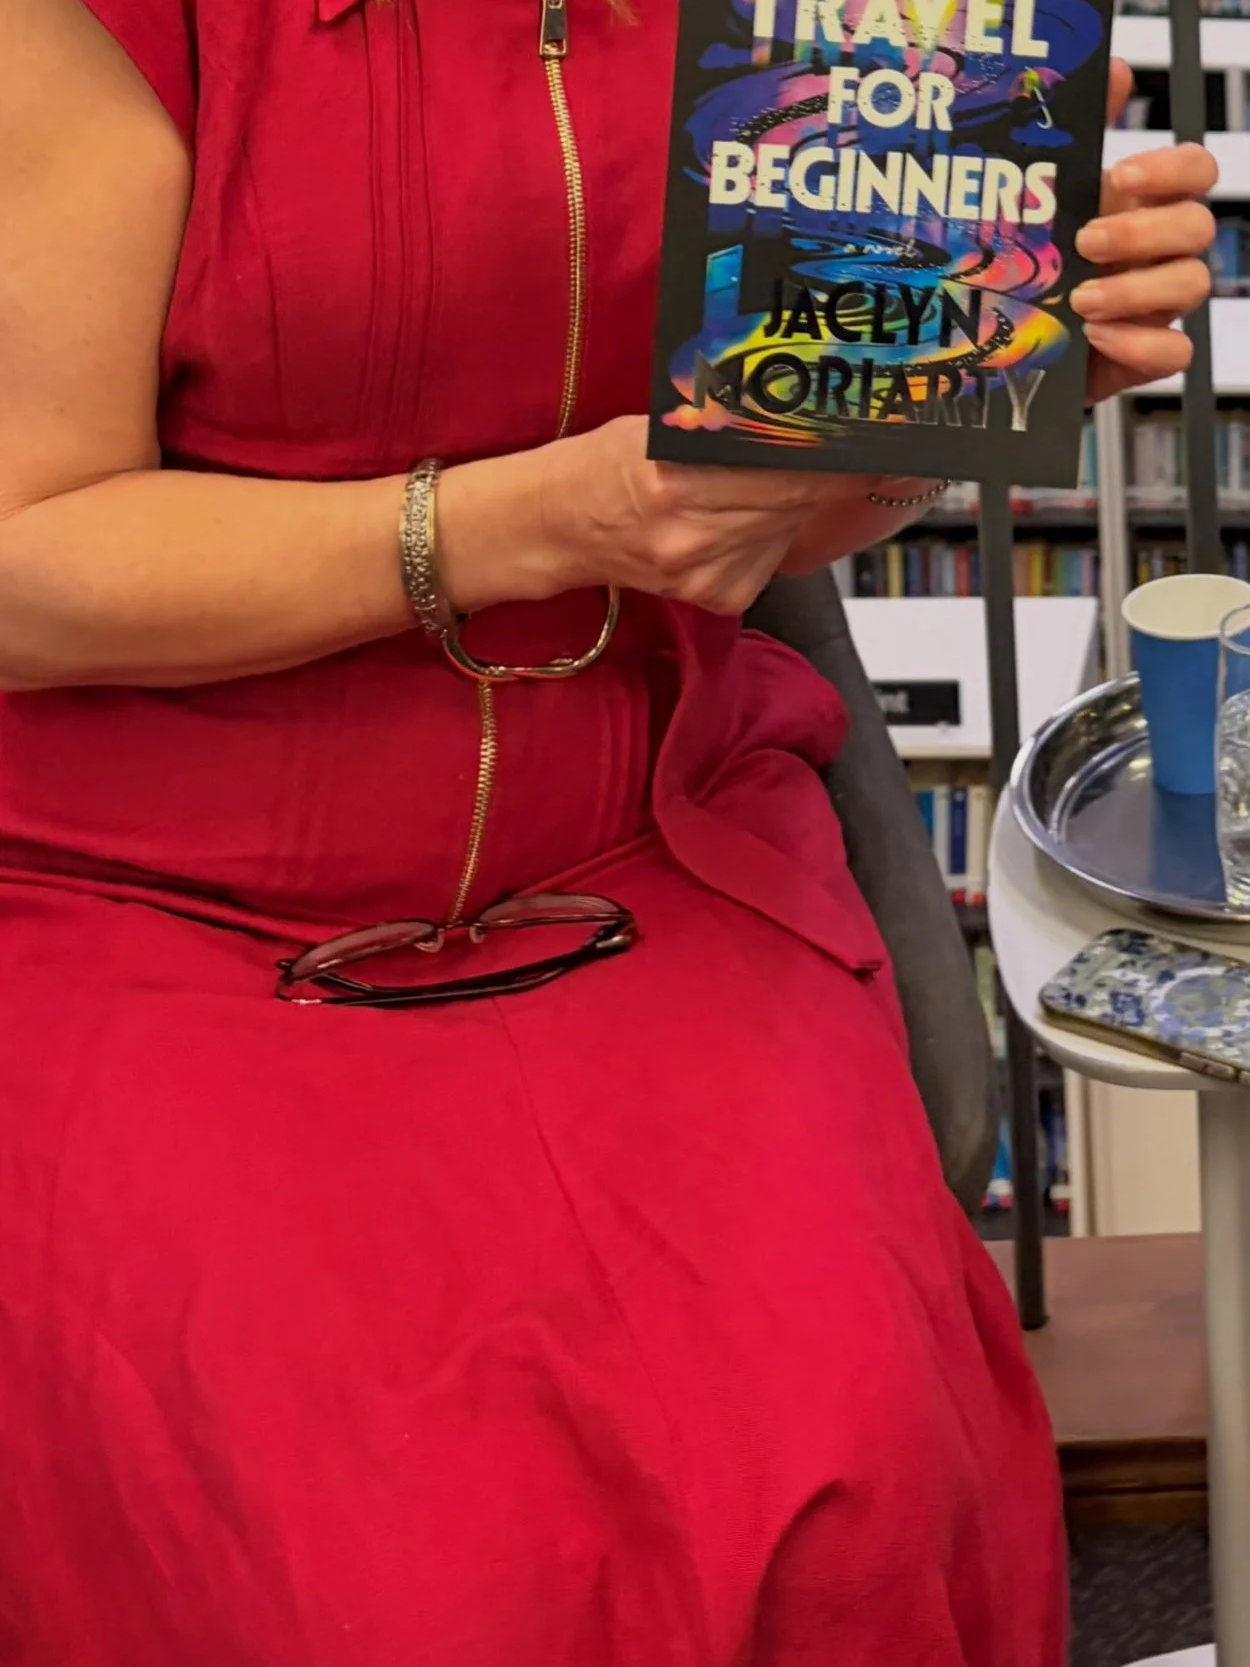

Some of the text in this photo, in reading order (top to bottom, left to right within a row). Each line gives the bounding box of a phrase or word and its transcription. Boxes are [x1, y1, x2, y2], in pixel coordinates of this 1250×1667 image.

[828, 67, 955, 132] FOR
[708, 141, 1057, 224] BEGINNERS
[862, 239, 915, 258] novel
[763, 278, 981, 347] JACLYN
[693, 350, 1046, 432] MORIARTY
